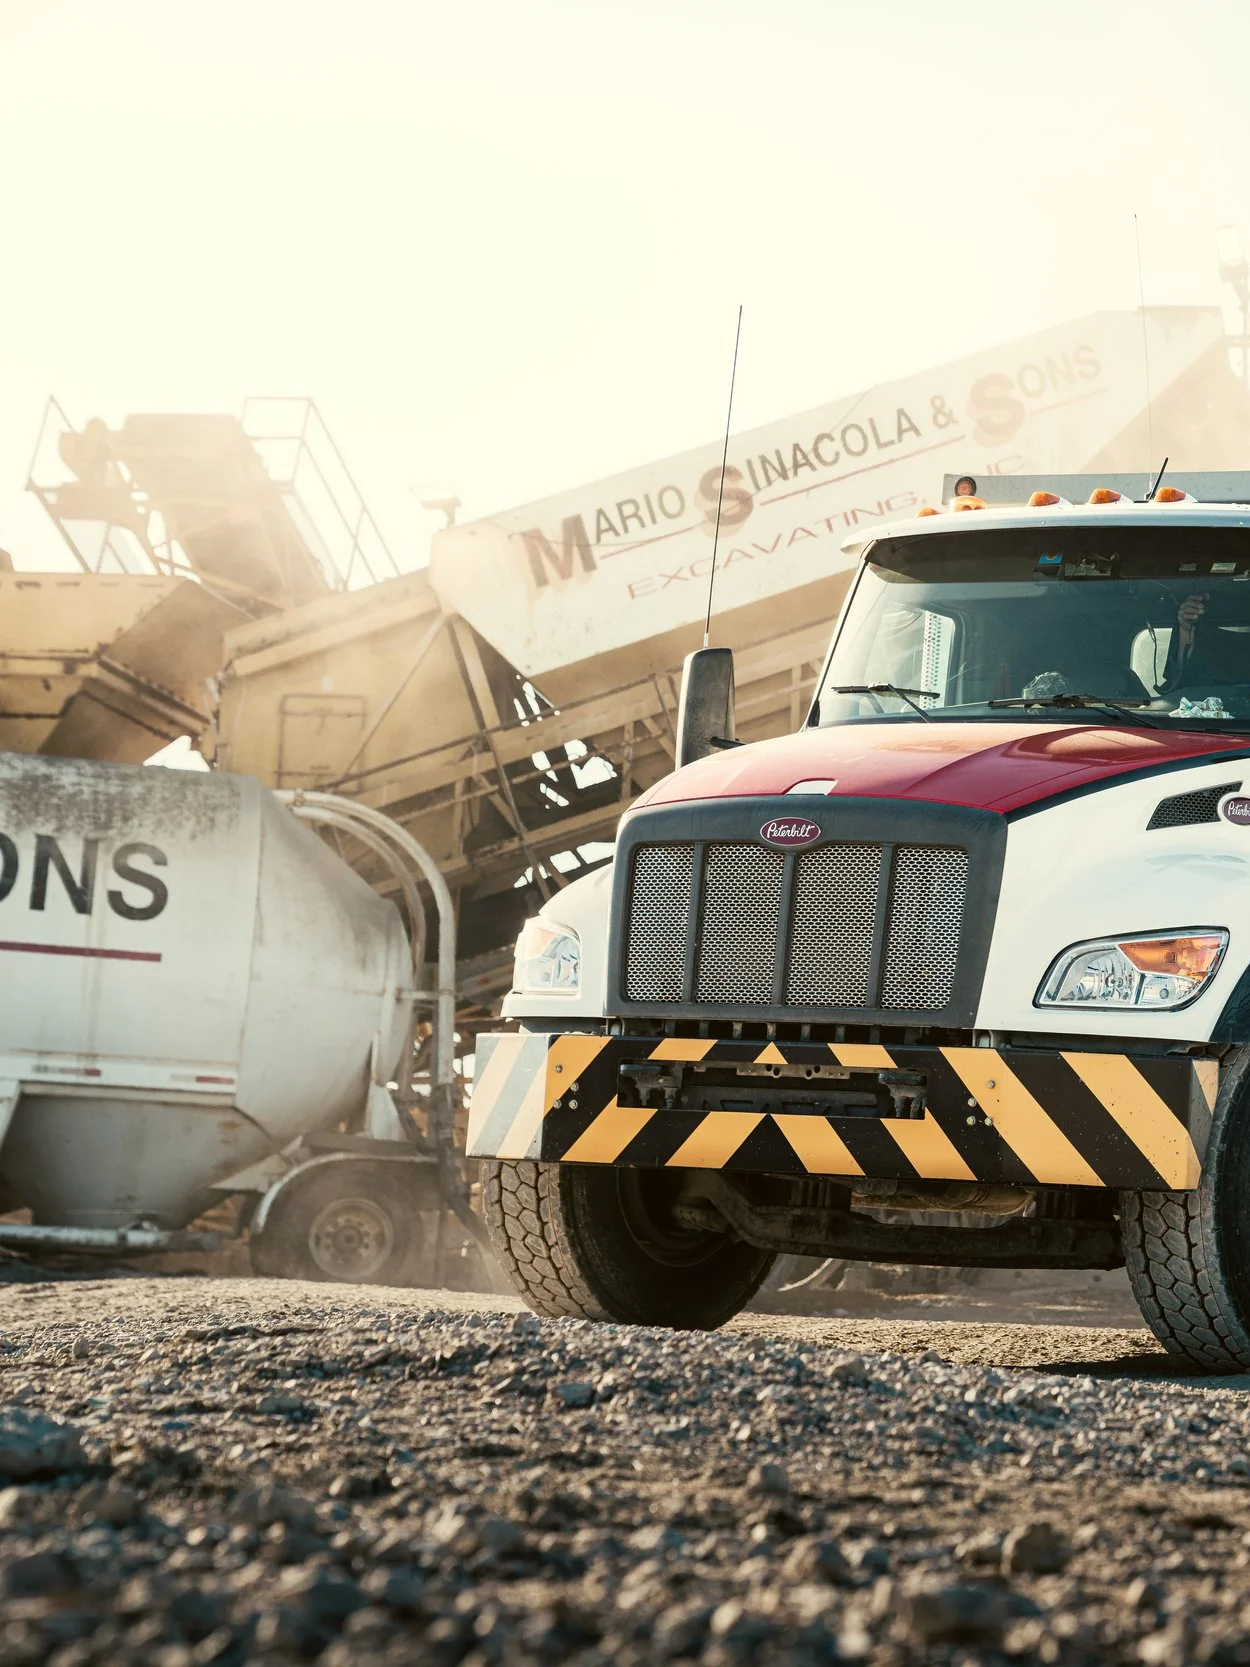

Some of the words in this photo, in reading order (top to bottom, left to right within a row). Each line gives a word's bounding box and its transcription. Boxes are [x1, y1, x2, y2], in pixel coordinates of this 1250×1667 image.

[520, 484, 687, 590] MARIO
[694, 407, 922, 538] SINACOLA
[930, 394, 960, 430] &
[968, 344, 1101, 446] SONS
[766, 821, 816, 839] Peterbilt
